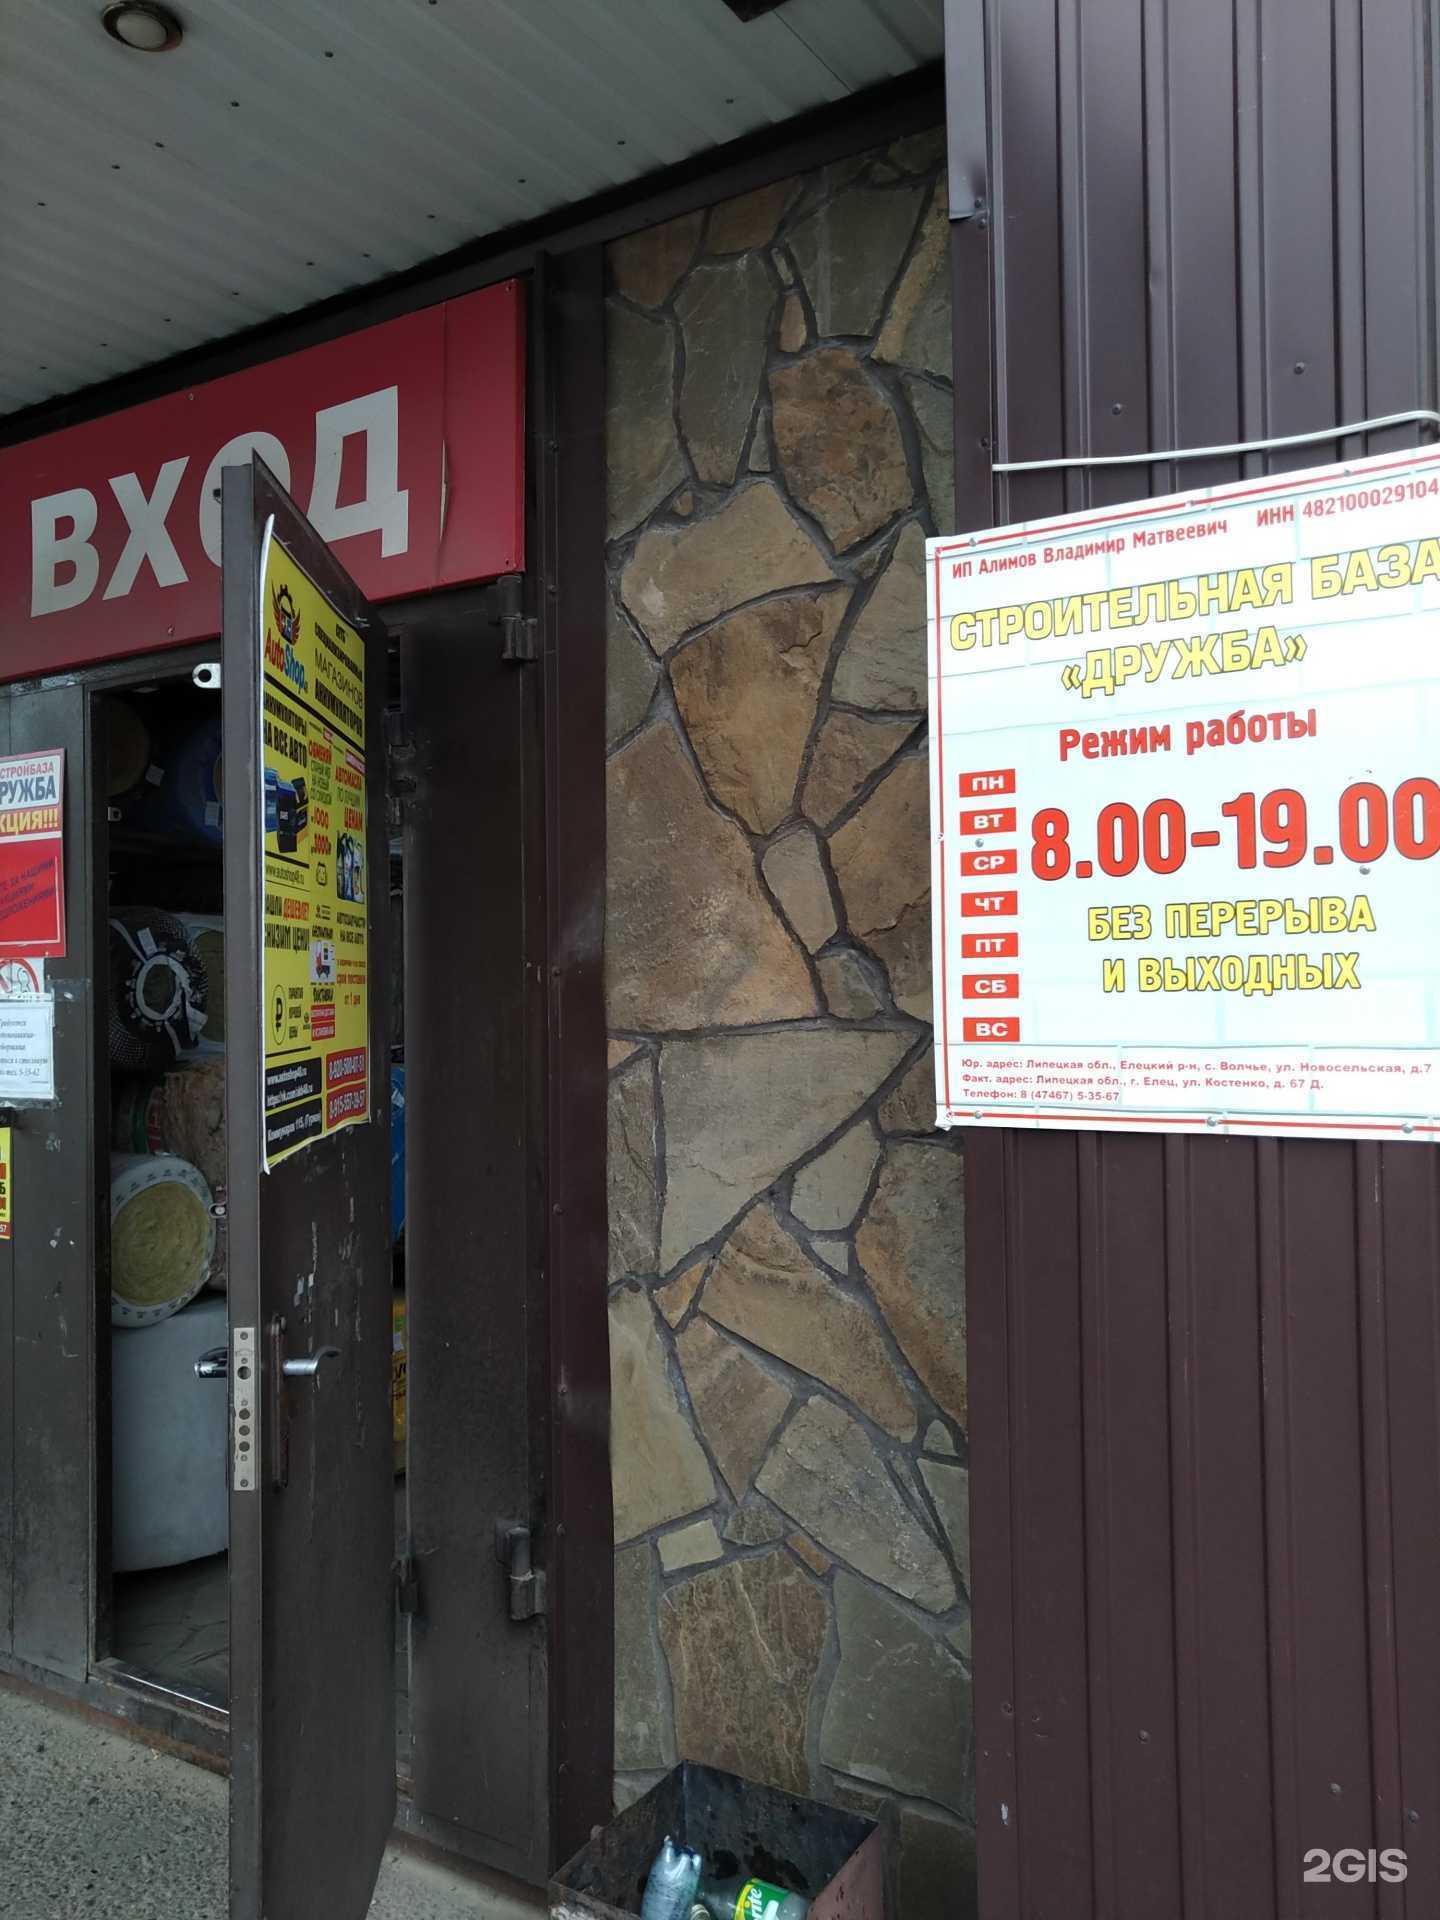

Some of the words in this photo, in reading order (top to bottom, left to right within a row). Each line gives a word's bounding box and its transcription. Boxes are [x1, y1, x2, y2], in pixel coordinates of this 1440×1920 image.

[952, 561, 972, 579] ИП
[979, 553, 1036, 575] Алимов
[1043, 537, 1125, 564] Владимир
[1132, 519, 1228, 548] Матвеевич
[1256, 504, 1294, 527] ИНН
[1302, 478, 1440, 518] 482100029104
[950, 562, 1294, 651] СТРОИТЕЛЬНАЯ
[1310, 537, 1440, 600] БАЗА
[264, 627, 304, 694] AutoShop
[1061, 626, 1308, 699] «ДРУЖБА»
[1059, 723, 1170, 763] Режим
[1186, 708, 1317, 755] работы
[0, 761, 54, 779] СТРОЙБАЗА
[971, 775, 1005, 791] ПН
[973, 813, 1004, 830] ВТ
[972, 855, 1006, 871] СР
[974, 896, 1004, 912] ЧТ
[1087, 904, 1152, 942] БЕЗ
[1165, 894, 1377, 939] ПЕРЕРЫВА
[975, 938, 1006, 953] ПТ
[1102, 958, 1126, 993] И
[1138, 951, 1362, 997] ВЫХОДНЫХ
[974, 979, 1008, 994] СБ
[975, 1022, 1008, 1037] ВС
[961, 1059, 982, 1069] Юр.
[986, 1060, 1023, 1070] адрес:
[1026, 1060, 1085, 1071] Липецкая
[1120, 1060, 1173, 1072] Елецкий
[1219, 1061, 1271, 1073] Волчье,
[1276, 1064, 1295, 1074] ул.
[1300, 1063, 1406, 1075] Новосельская,
[1410, 1064, 1432, 1074] д.7
[962, 1074, 992, 1084] Факт.
[995, 1076, 1033, 1086] адрес:
[1036, 1075, 1093, 1086] Липецкая
[1130, 1078, 1140, 1086] г.
[1143, 1076, 1178, 1087] Елец,
[1182, 1079, 1200, 1088] ул.
[1205, 1078, 1269, 1090] Костенко,
[1274, 1080, 1285, 1089] д.
[1290, 1079, 1305, 1088] 67
[1310, 1080, 1324, 1090] Д.
[963, 1089, 1017, 1100] Телефон:
[1020, 1090, 1027, 1098] 8
